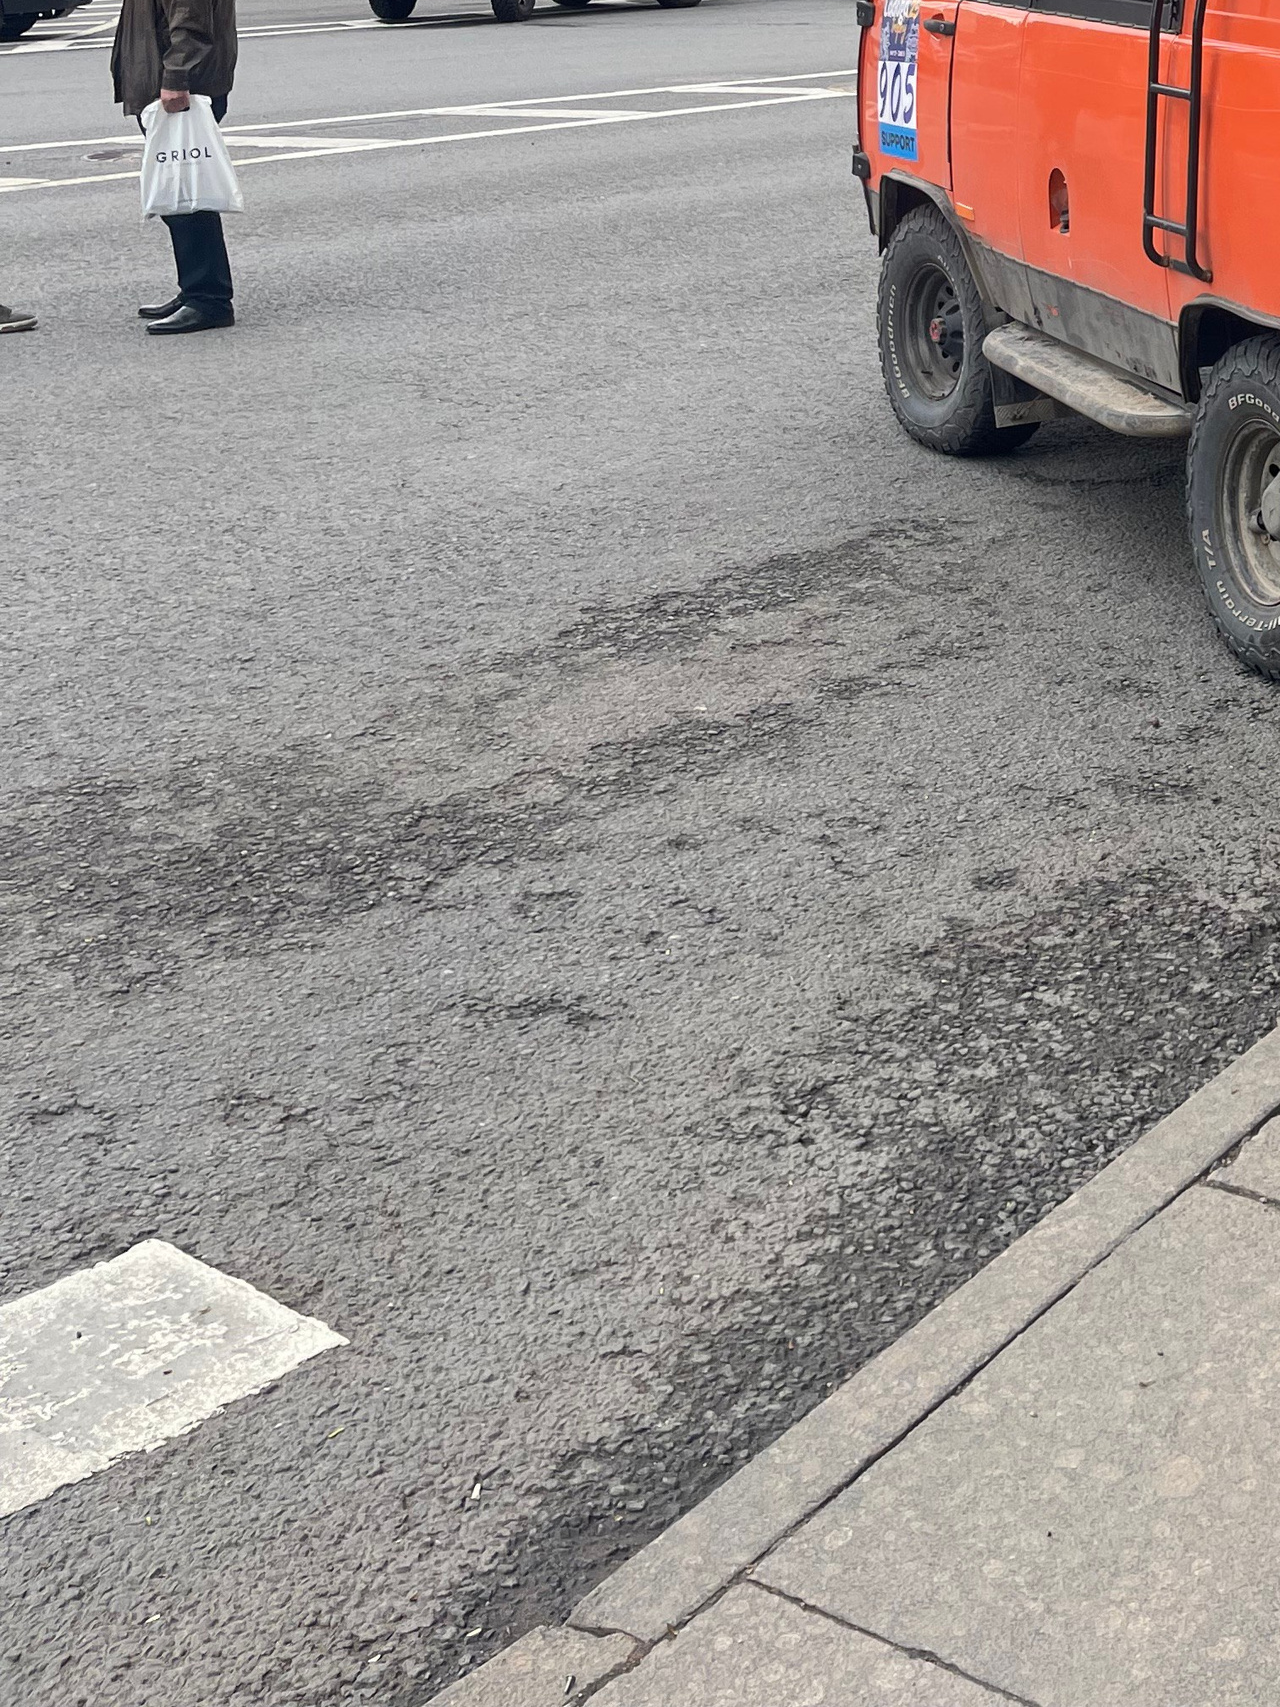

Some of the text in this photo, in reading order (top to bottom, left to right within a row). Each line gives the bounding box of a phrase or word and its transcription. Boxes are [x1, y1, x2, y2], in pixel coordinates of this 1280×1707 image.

[879, 62, 916, 124] 905
[881, 130, 916, 153] SUPPORT
[156, 146, 213, 164] GRIOL
